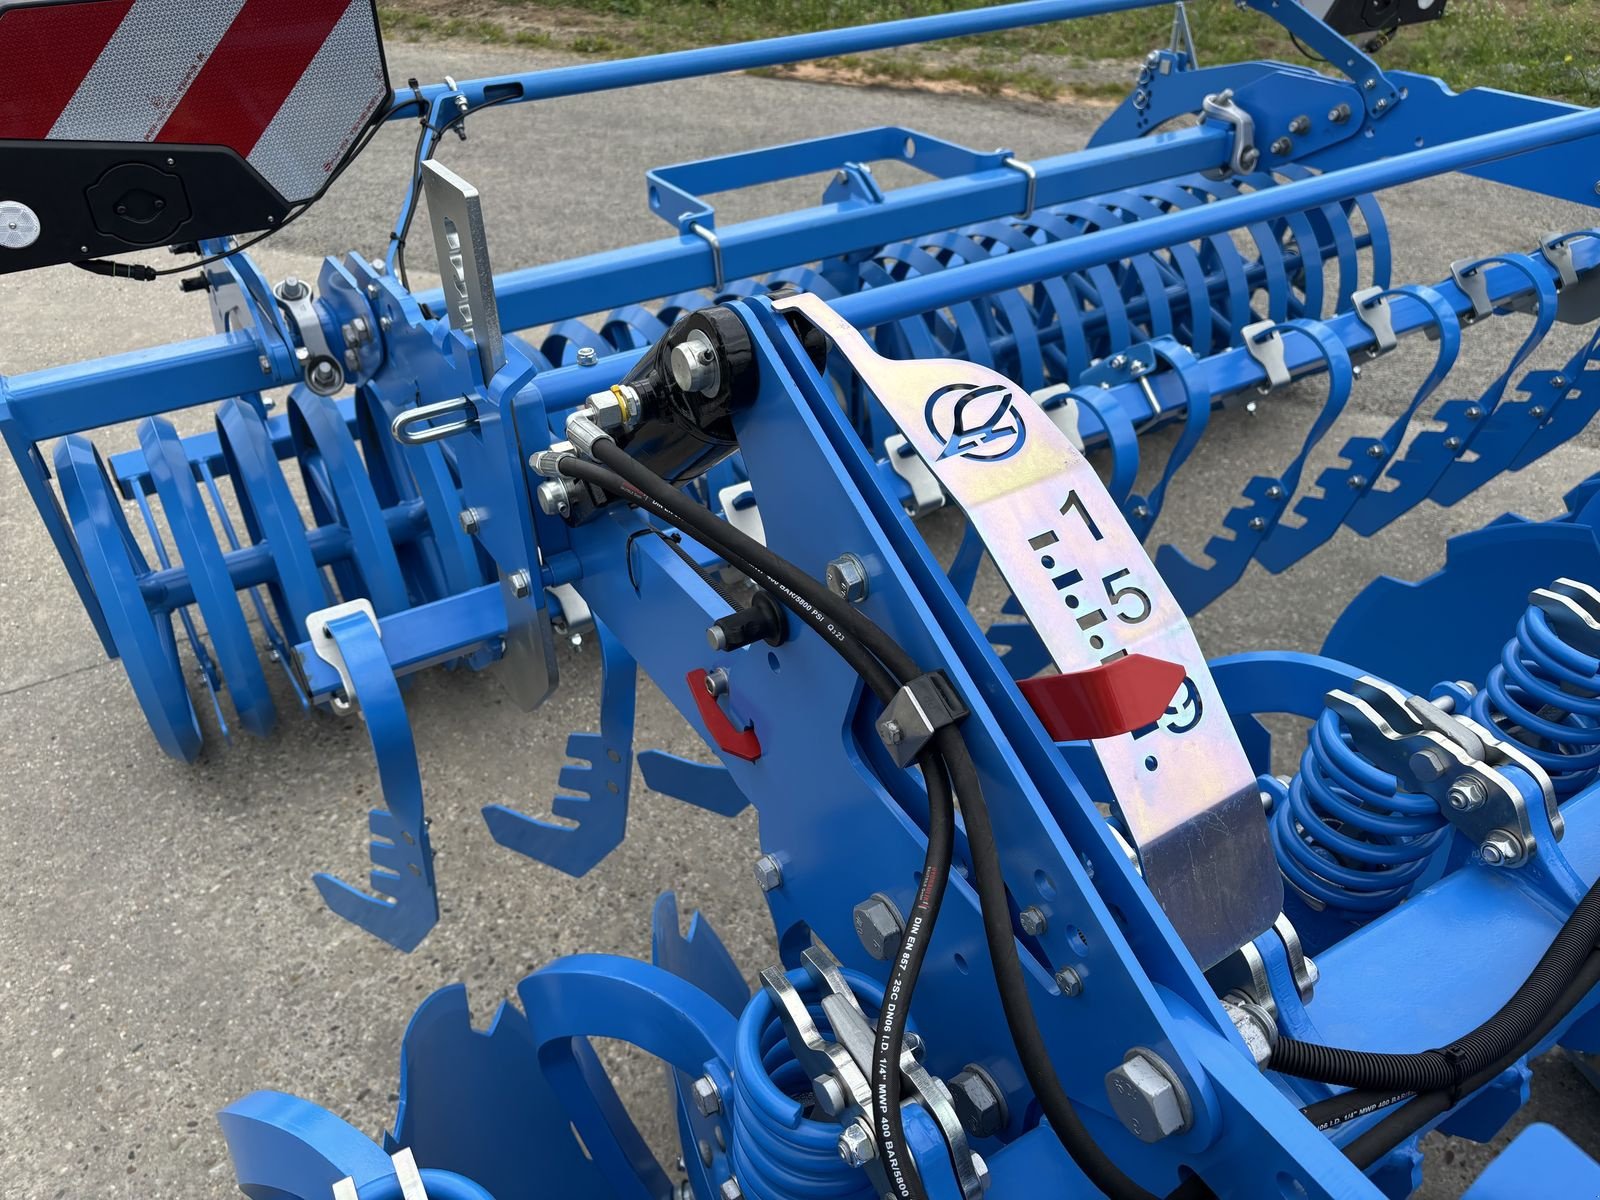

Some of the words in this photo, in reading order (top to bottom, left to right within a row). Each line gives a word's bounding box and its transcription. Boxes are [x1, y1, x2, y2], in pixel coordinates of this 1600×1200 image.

[1059, 489, 1104, 542] 1
[1101, 567, 1152, 625] 5
[811, 609, 825, 622] PSI
[1162, 675, 1204, 734] 9
[911, 916, 923, 935] DIN
[904, 936, 916, 951] EN
[899, 953, 910, 971] 857
[890, 979, 902, 1001] 2SC
[883, 1003, 896, 1032] DN06
[882, 1035, 890, 1054] I.D.
[878, 1058, 888, 1081] 1/4"
[878, 1083, 888, 1114] MWP
[1359, 1104, 1377, 1115] MWP
[880, 1116, 891, 1138] 400
[884, 1141, 910, 1197] BAR/5800
